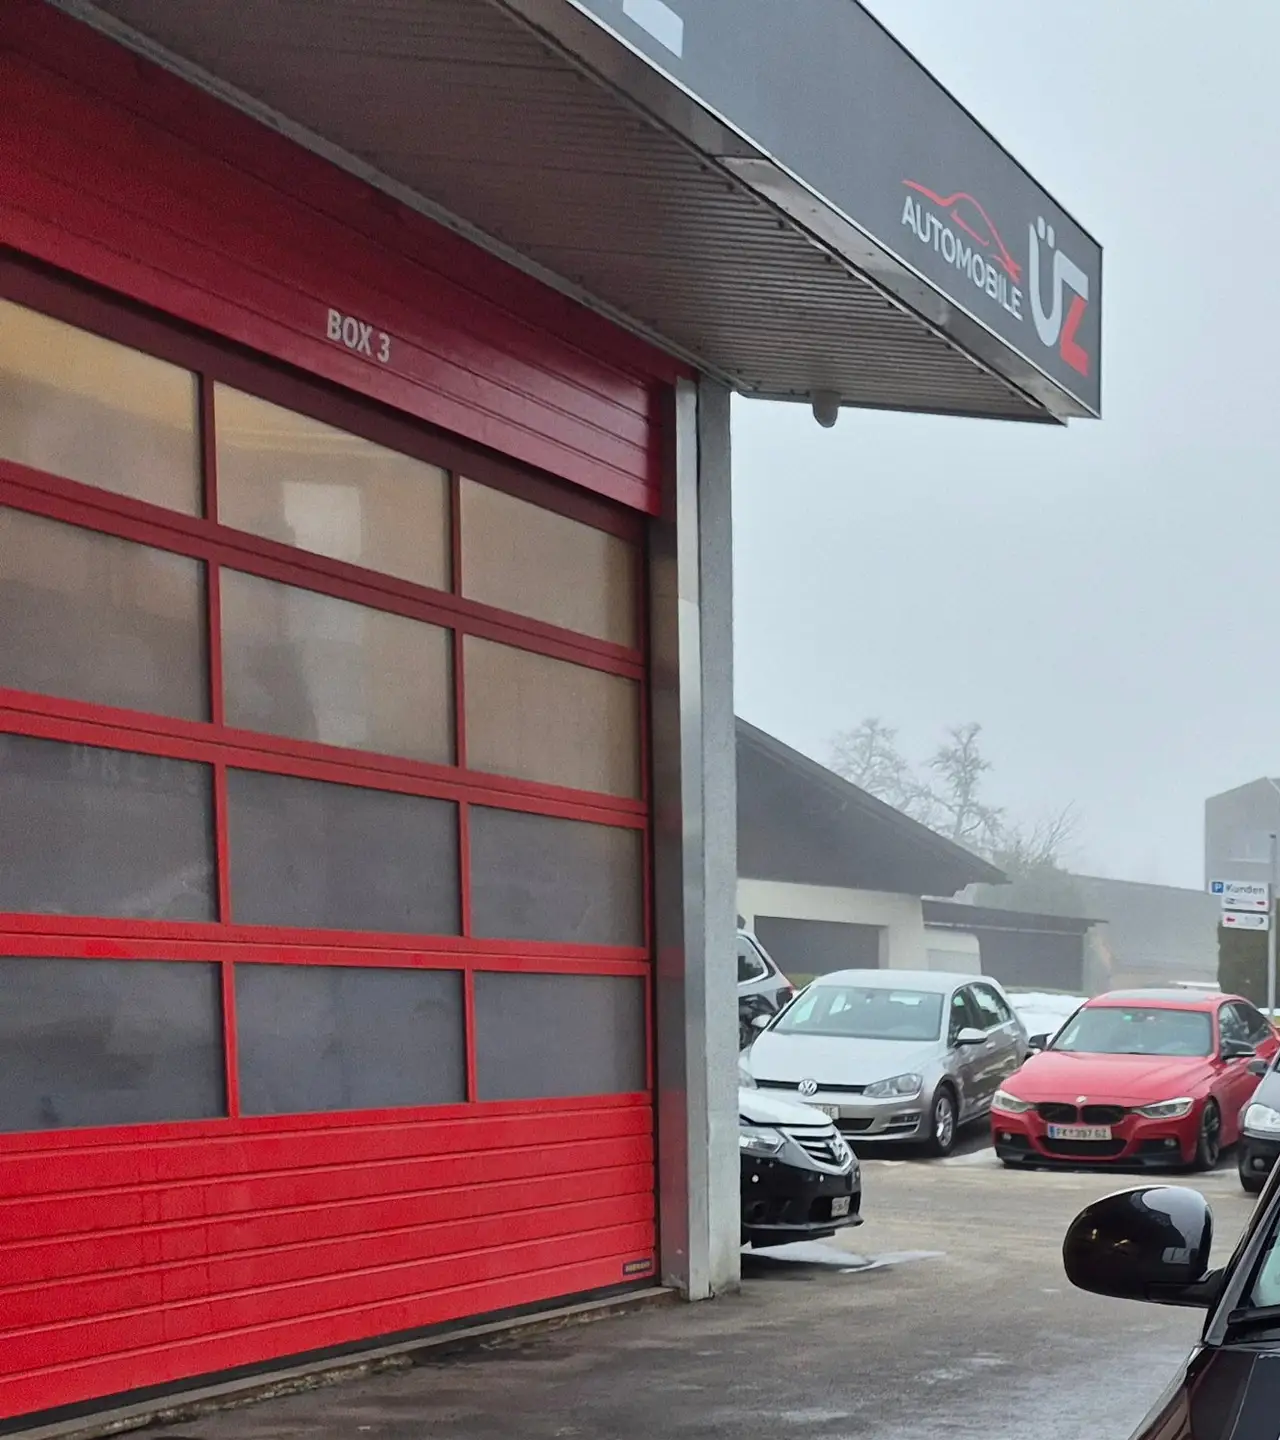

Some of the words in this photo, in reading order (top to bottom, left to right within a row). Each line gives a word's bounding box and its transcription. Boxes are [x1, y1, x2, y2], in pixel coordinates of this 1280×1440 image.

[901, 196, 1024, 321] AUTOMOBILE
[1028, 216, 1089, 378] ÜZ
[327, 308, 373, 356] BOX
[377, 332, 391, 363] 3
[1226, 883, 1265, 895] Kunden
